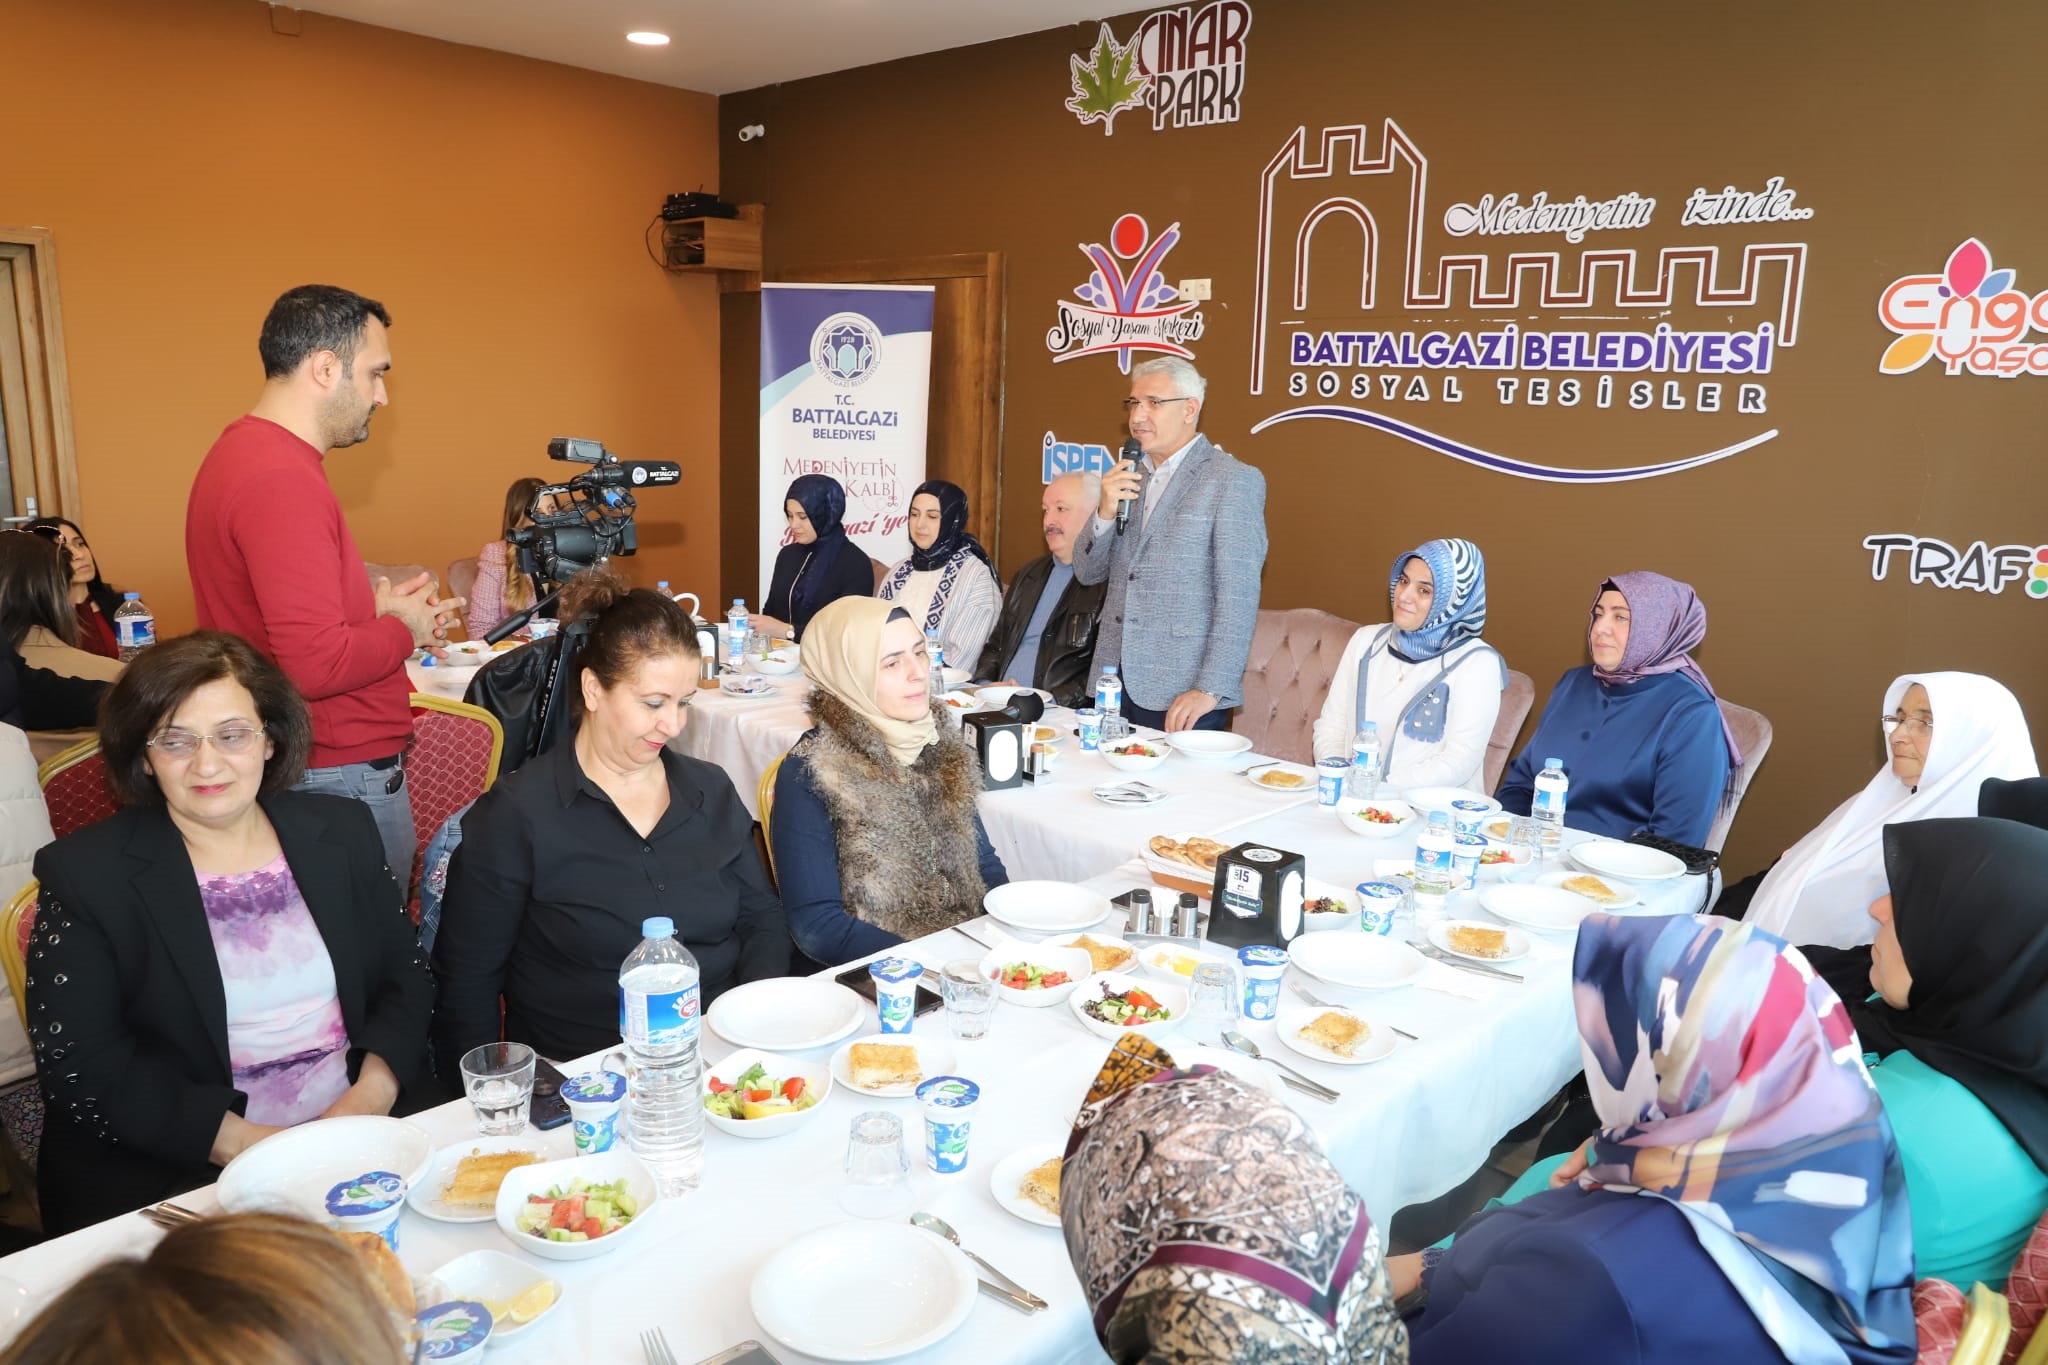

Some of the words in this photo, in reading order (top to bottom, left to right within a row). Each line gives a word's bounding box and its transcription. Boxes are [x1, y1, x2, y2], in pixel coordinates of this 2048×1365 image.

[1137, 1, 1249, 85] ÇINAR
[1154, 64, 1242, 128] PARK
[1446, 193, 1652, 241] Medeniyetin
[1048, 307, 1103, 350] Sosyal
[1106, 315, 1151, 343] Yaşam
[1153, 313, 1202, 339] Merkezi
[1293, 326, 1516, 367] BATTALGAZİ
[1523, 326, 1771, 371] BELEDİYESİ
[835, 394, 855, 406] T.C.
[1291, 373, 1460, 400] SOSYAL
[1500, 377, 1763, 410] TESİSLER
[784, 457, 897, 479] MEDENİYETİN
